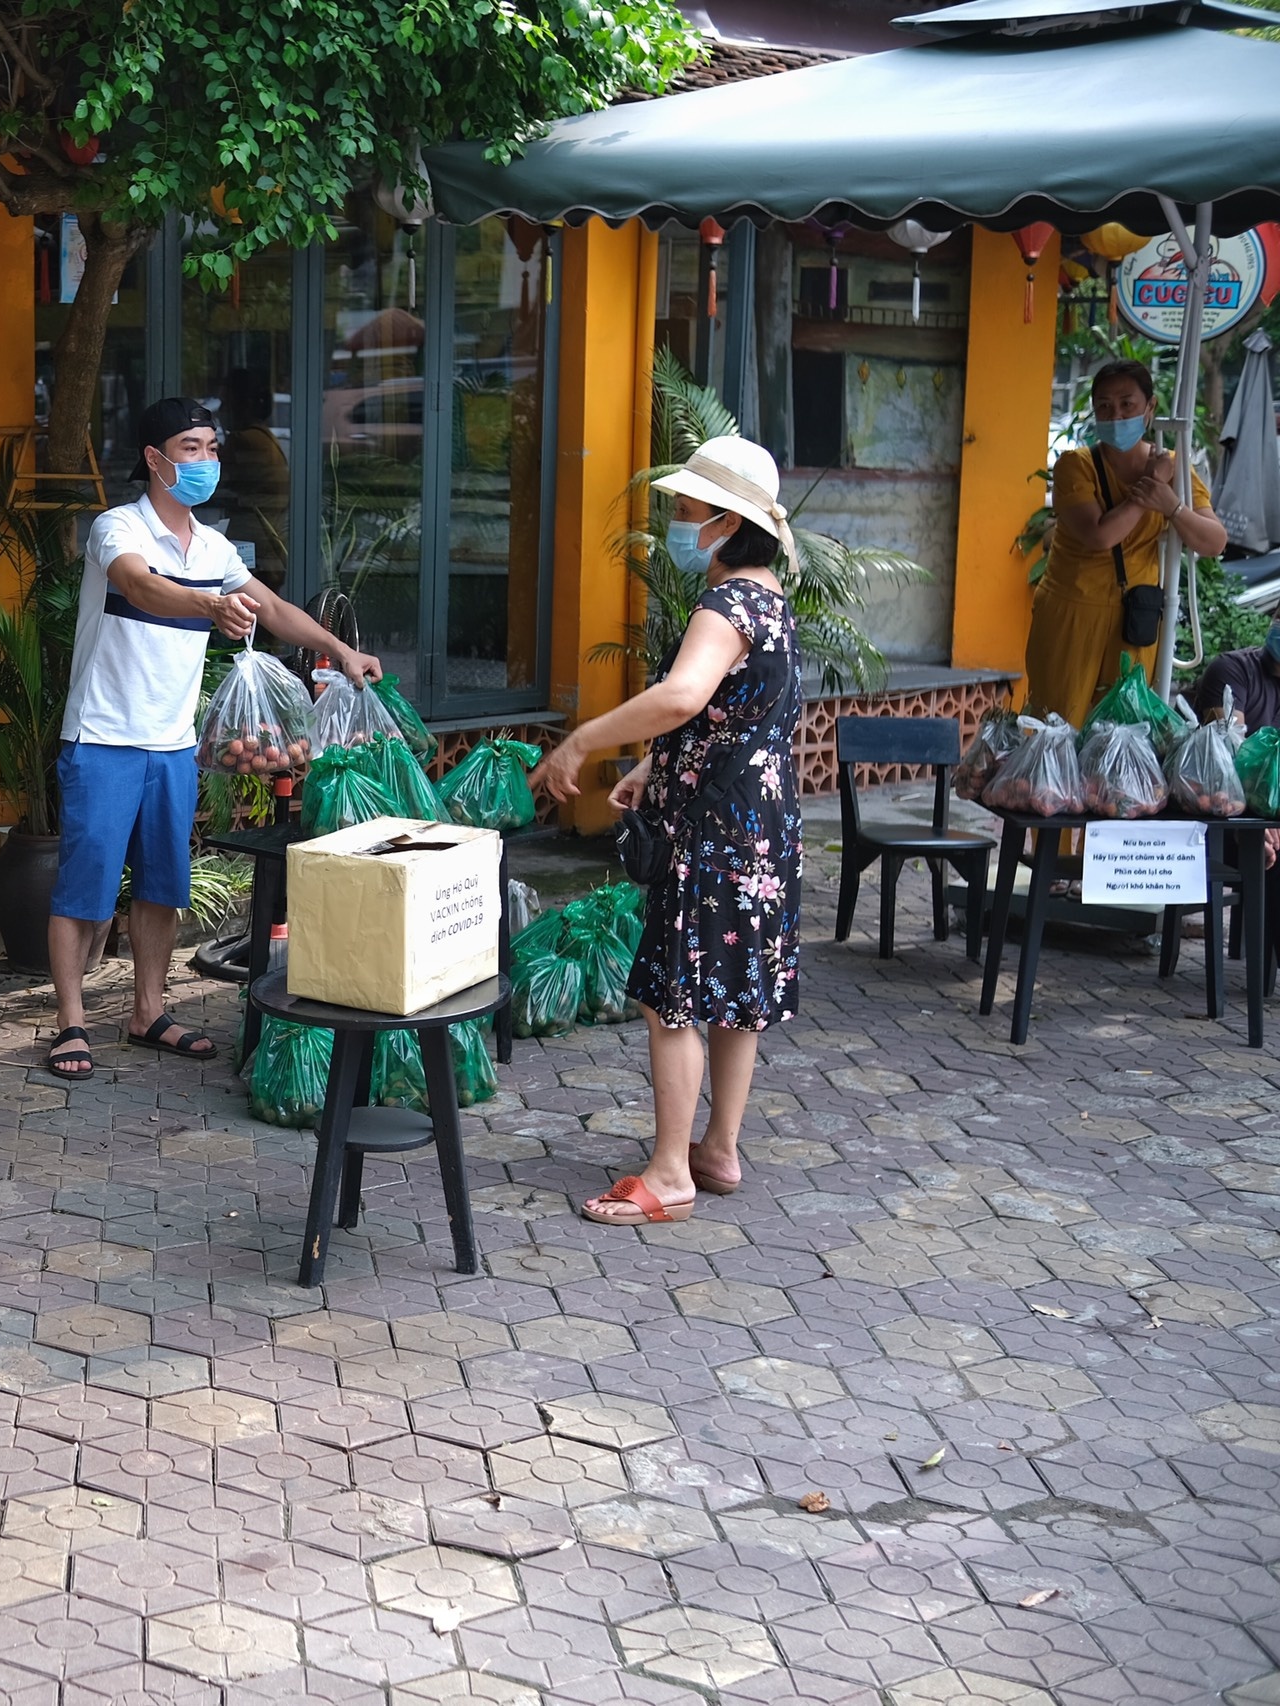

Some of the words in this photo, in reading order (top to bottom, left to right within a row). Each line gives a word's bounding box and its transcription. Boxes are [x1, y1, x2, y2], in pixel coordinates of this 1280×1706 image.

[1138, 839, 1151, 847] bạn
[1153, 839, 1166, 847] cần
[1119, 853, 1133, 862] một
[1135, 853, 1155, 861] chùm
[1156, 853, 1165, 861] và
[1177, 853, 1196, 861] dành
[1114, 867, 1132, 876] Phần
[1133, 867, 1147, 876] còn
[1148, 867, 1158, 877] lại
[1158, 867, 1173, 876] cho
[453, 880, 463, 895] Hộ
[464, 873, 479, 889] Quỹ
[1106, 881, 1129, 891] Người
[1130, 881, 1144, 890] khó
[1145, 881, 1164, 890] khăn
[1166, 881, 1181, 890] hơn
[430, 902, 459, 922] VACXIN
[461, 895, 483, 911] chống
[431, 928, 446, 944] dịch
[448, 913, 484, 936] COVID-19
